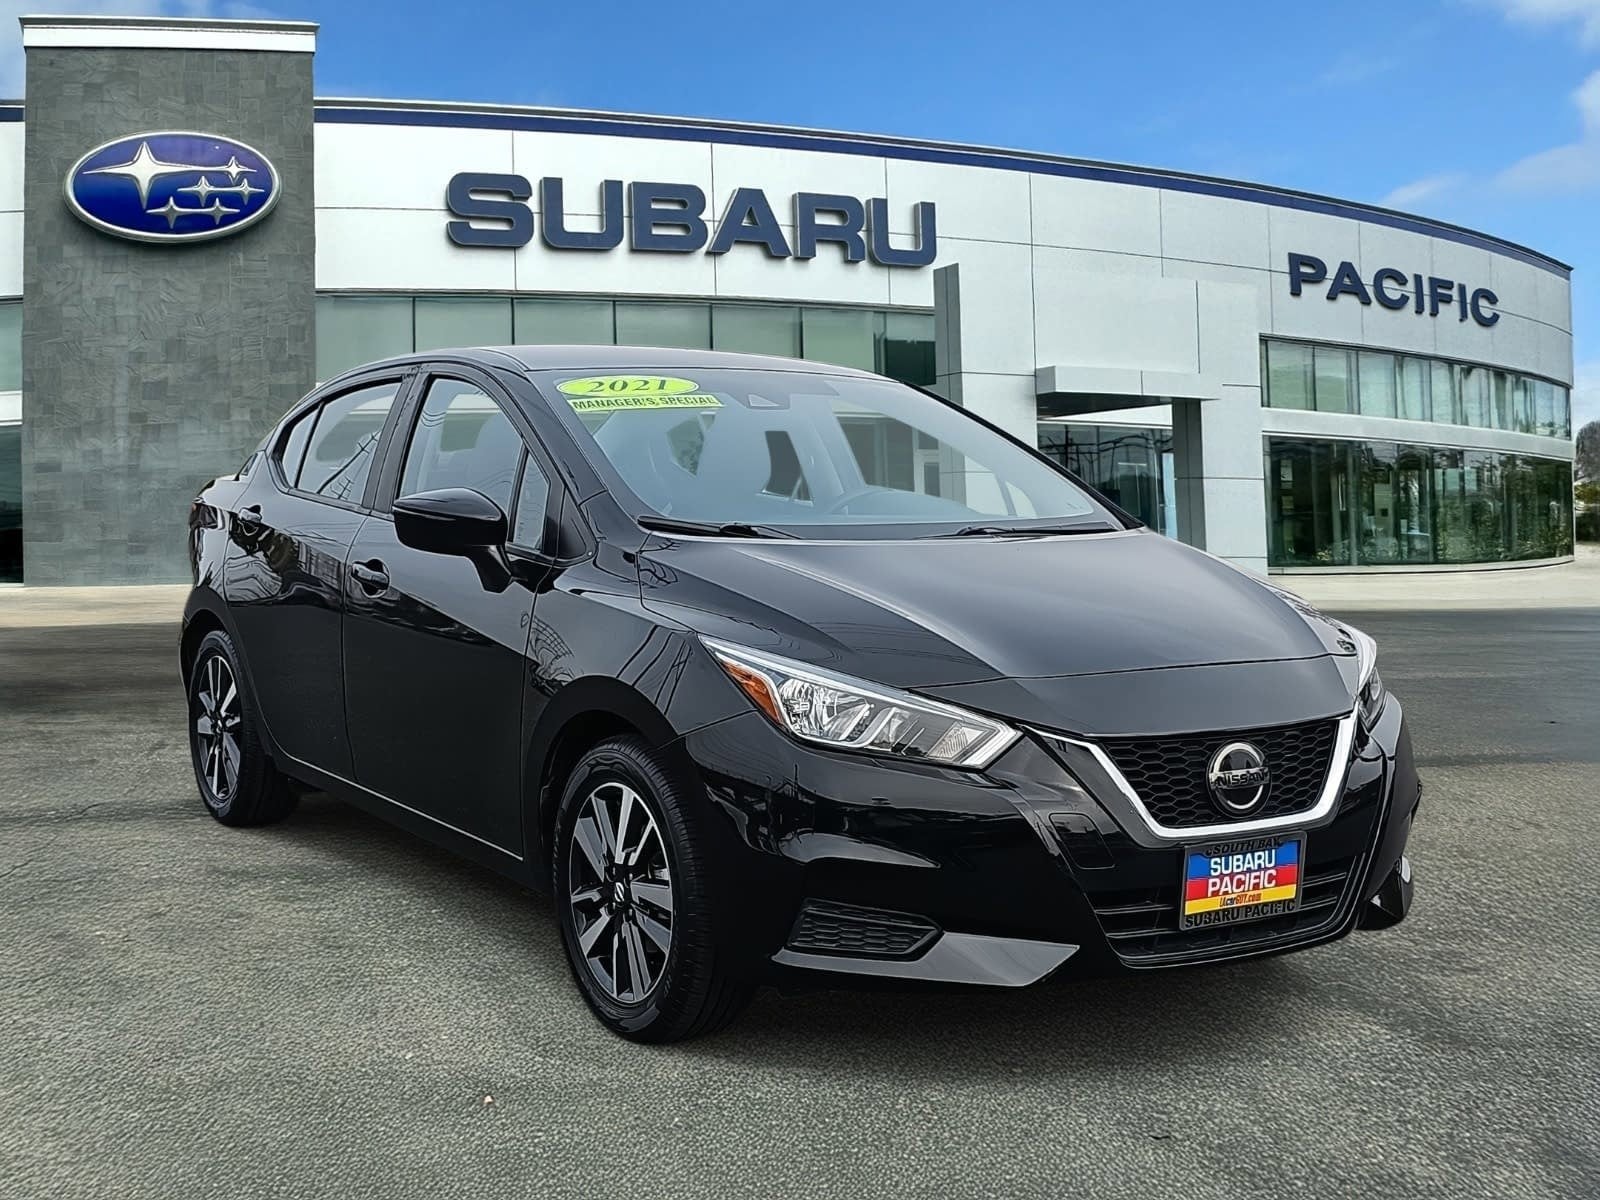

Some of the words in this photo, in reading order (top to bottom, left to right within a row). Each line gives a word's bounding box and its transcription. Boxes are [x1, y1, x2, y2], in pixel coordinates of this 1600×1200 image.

[447, 172, 937, 268] SUBARU
[1288, 252, 1500, 327] PACIFIC
[589, 379, 667, 392] 2021
[659, 396, 715, 405] SPECIAL
[1216, 769, 1265, 786] NISSAN
[1213, 842, 1257, 854] SOUTH
[1210, 849, 1276, 876] SUBARU
[1207, 869, 1277, 897] PACIFIC
[1185, 908, 1240, 928] SUBARU
[1245, 900, 1296, 917] PACIFIC
